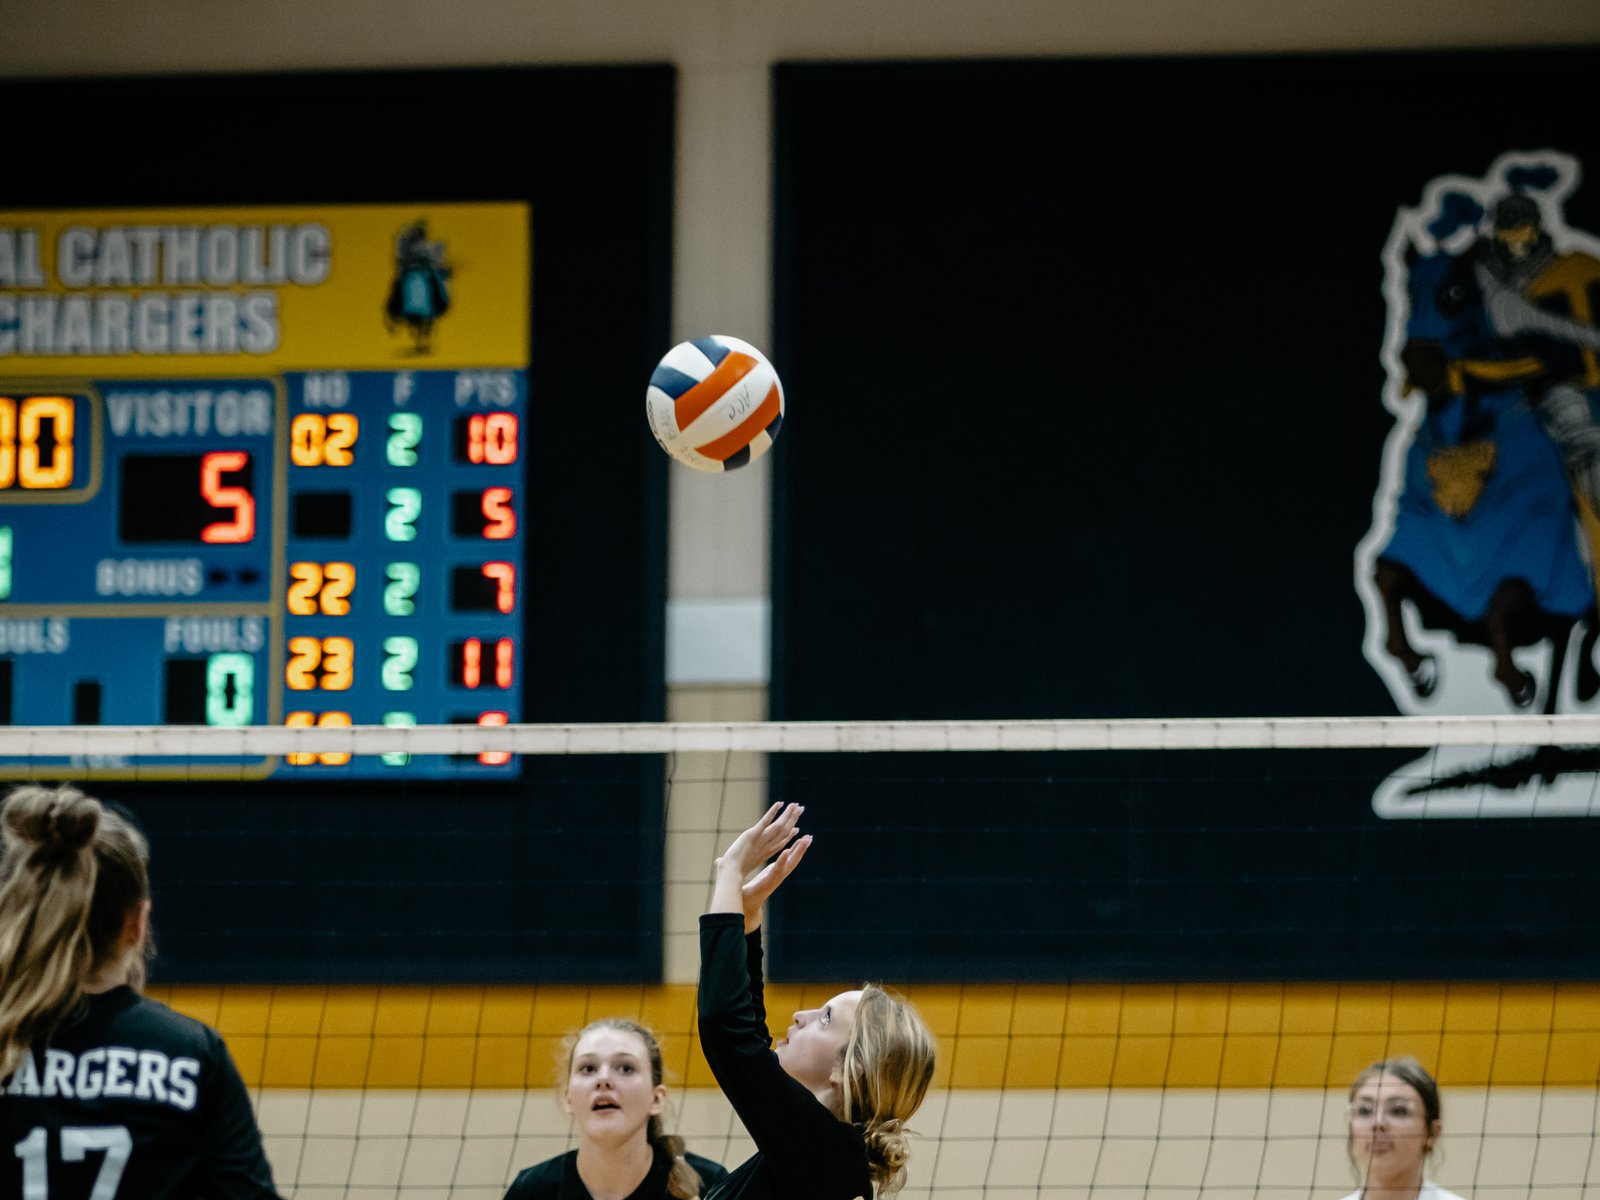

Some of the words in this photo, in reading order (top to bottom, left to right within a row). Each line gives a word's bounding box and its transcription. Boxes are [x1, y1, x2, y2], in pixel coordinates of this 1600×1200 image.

[58, 224, 331, 287] CATHOLIC
[0, 291, 280, 356] CHARGERS
[107, 390, 273, 436] VISITOR
[454, 371, 517, 408] PTS
[291, 413, 359, 467] 02
[386, 412, 423, 467] 2
[468, 411, 518, 465] 10
[200, 451, 255, 544] 5
[385, 487, 422, 541] 2
[481, 486, 517, 541] 5
[96, 559, 205, 596] BONUS
[287, 561, 356, 616] 22
[383, 561, 420, 616] 2
[481, 560, 515, 614] 7
[164, 616, 266, 654] FOULS
[206, 652, 254, 728] 0
[286, 636, 354, 691] 23
[381, 636, 418, 691] 2
[462, 637, 514, 689] 11
[0, 1046, 201, 1111] ARGERS
